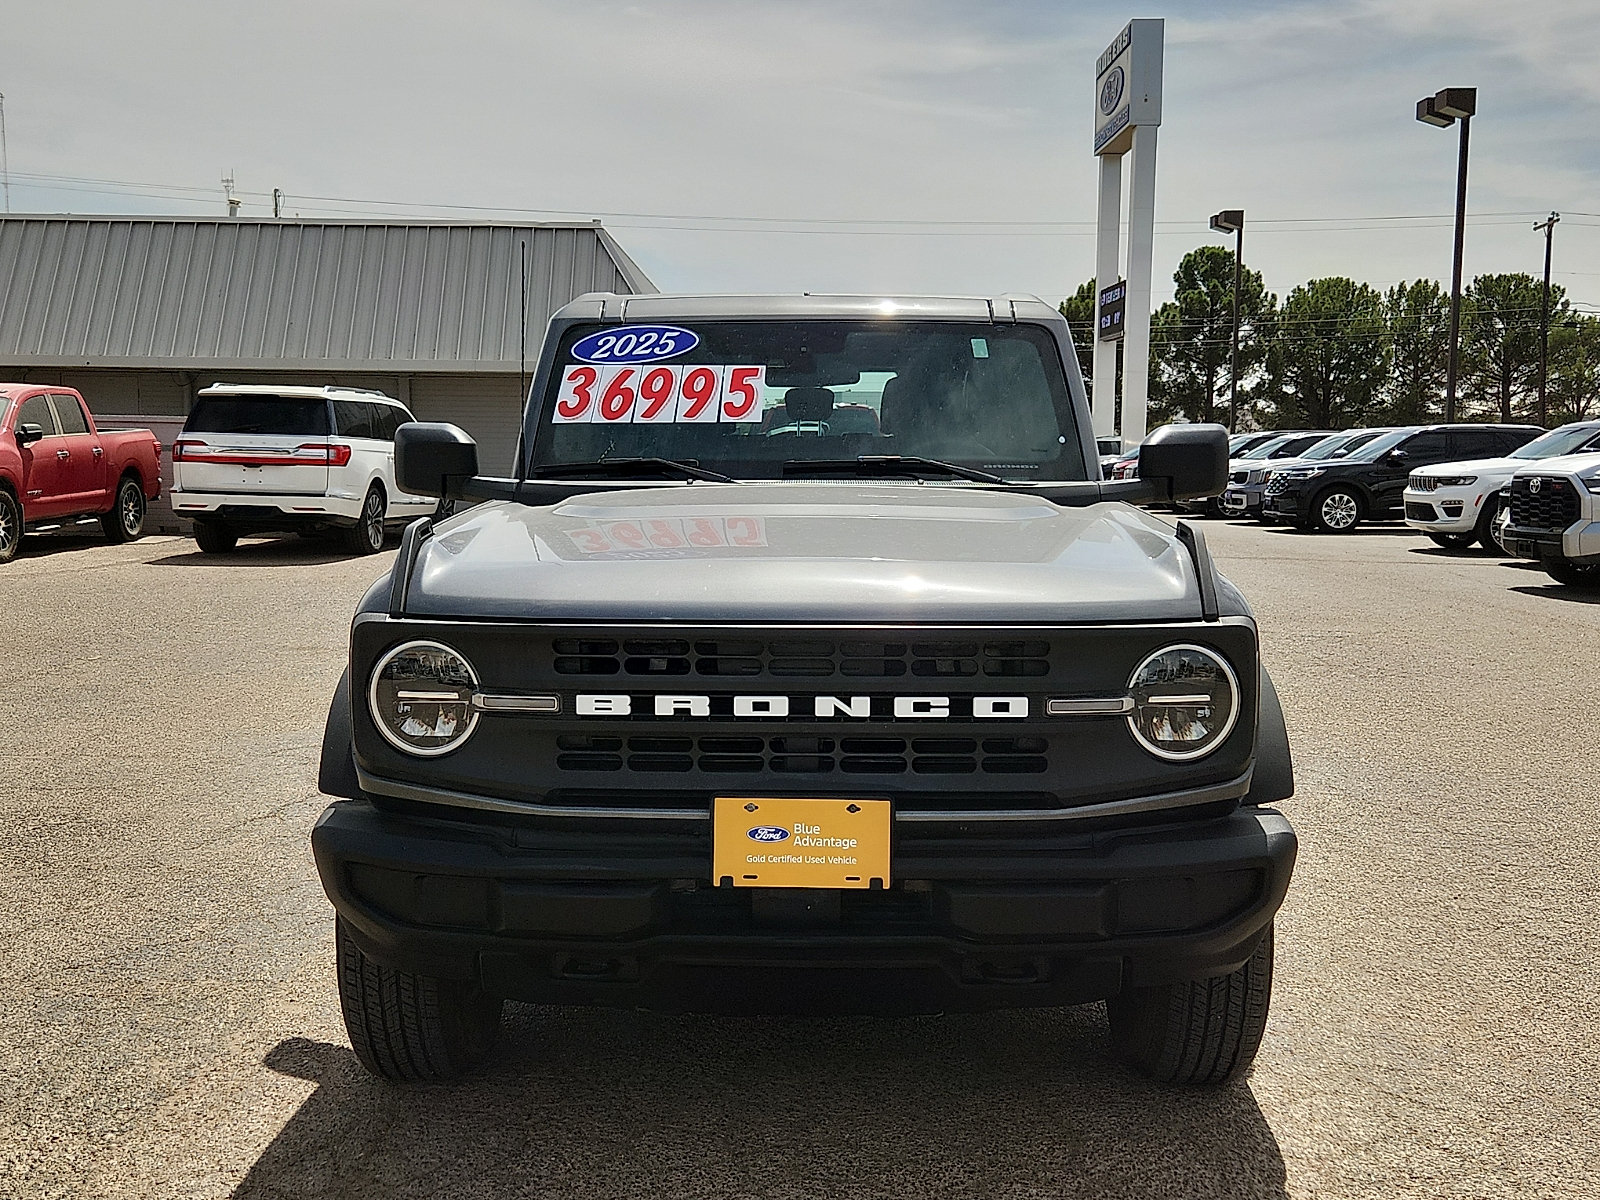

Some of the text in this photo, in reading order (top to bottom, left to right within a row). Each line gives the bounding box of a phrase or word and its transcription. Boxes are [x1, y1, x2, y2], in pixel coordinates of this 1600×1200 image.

[590, 331, 681, 359] 2025
[557, 366, 762, 421] 36995
[575, 694, 1029, 718] BRONCO
[755, 828, 782, 840] Ford
[793, 823, 821, 835] Blue
[793, 835, 857, 850] Advantage
[746, 855, 857, 865] Gold Certified Used Vehicle
